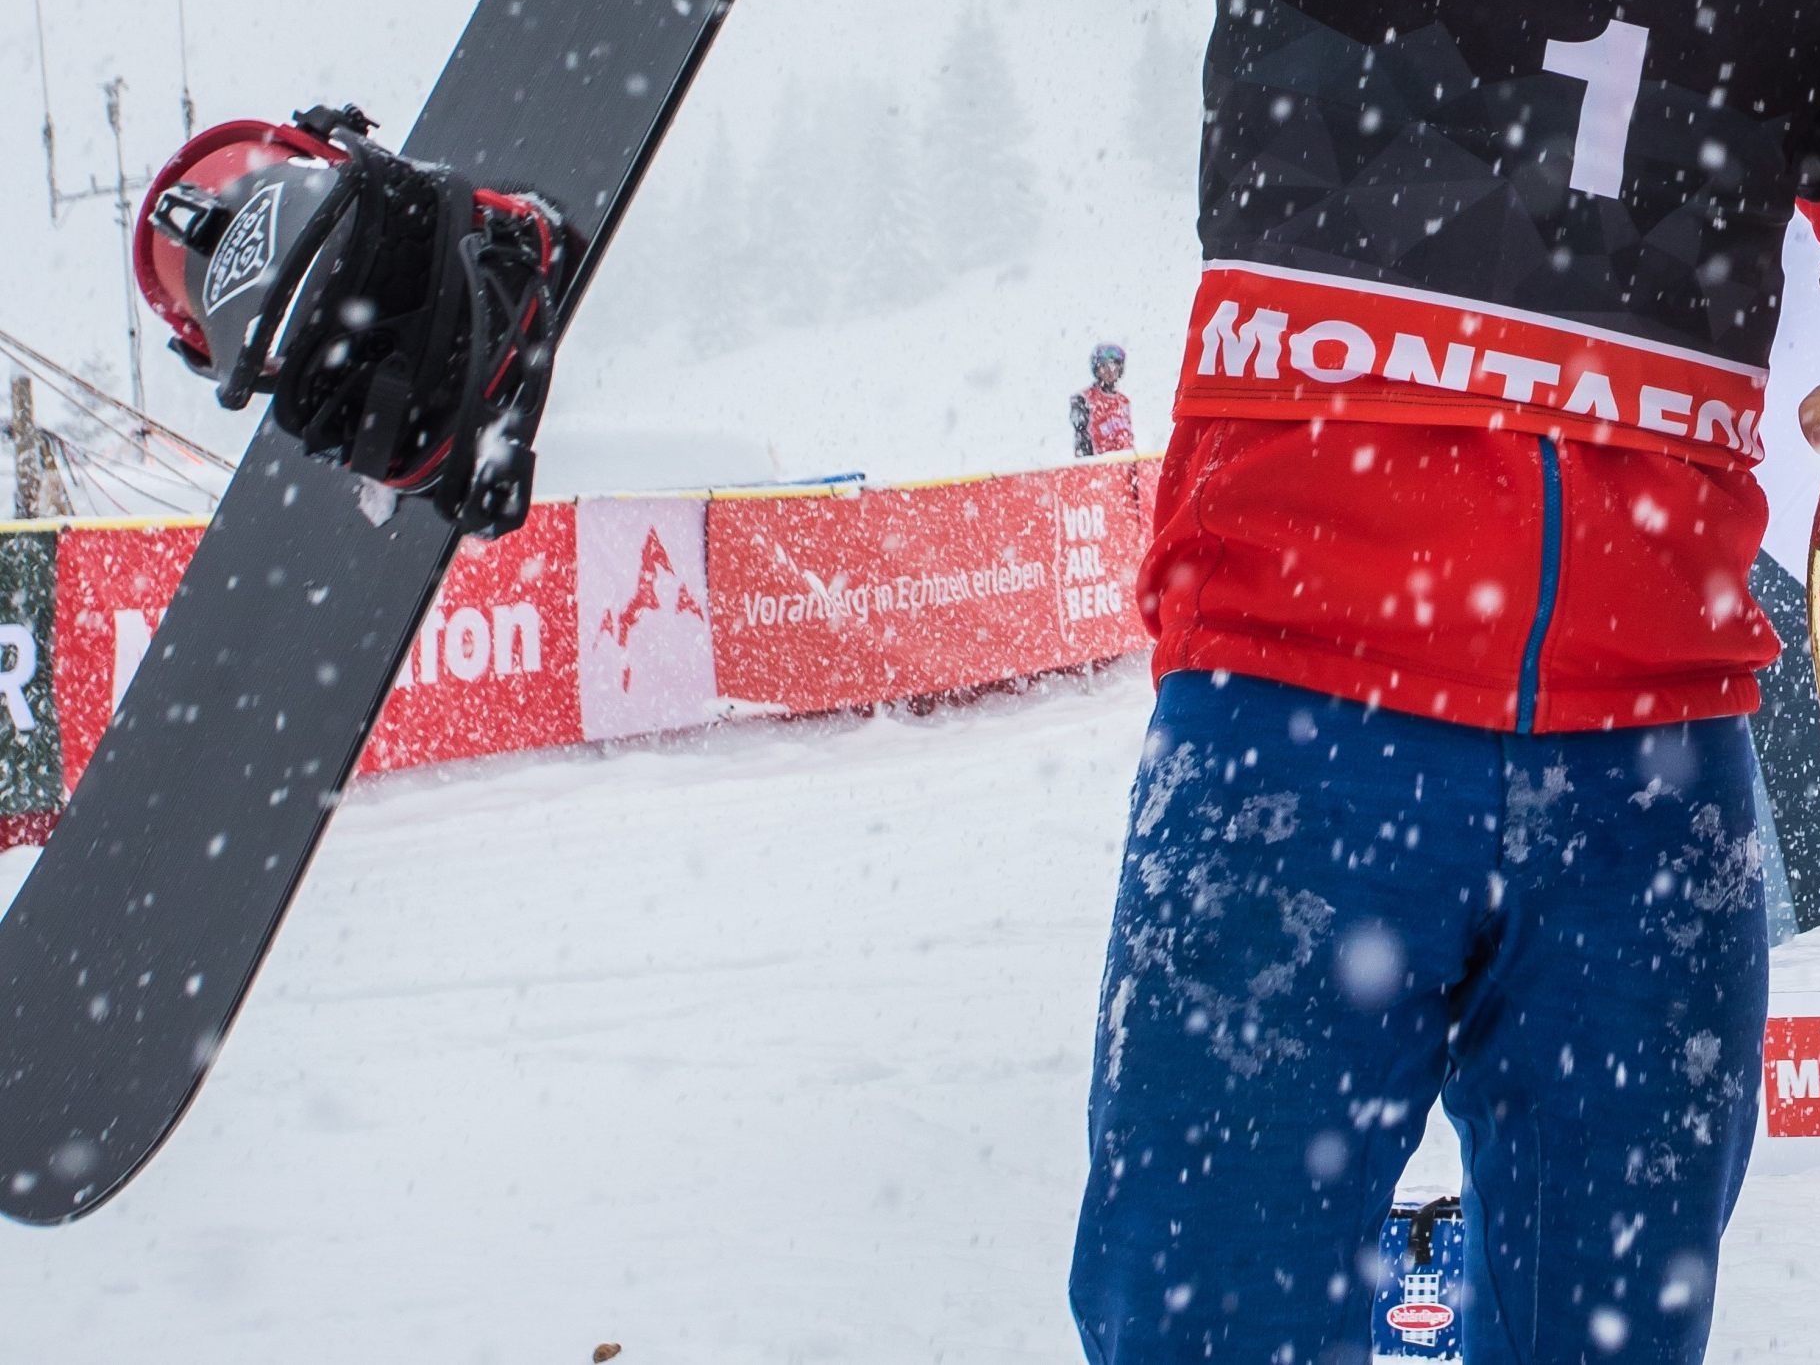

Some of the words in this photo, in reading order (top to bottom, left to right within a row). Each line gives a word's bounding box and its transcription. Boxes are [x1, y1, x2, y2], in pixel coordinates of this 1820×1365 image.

[1541, 18, 1650, 200] 1
[1062, 504, 1106, 541] VOR
[971, 560, 1046, 597] erleben
[1065, 544, 1105, 581] ARL
[1065, 582, 1123, 621] BERG
